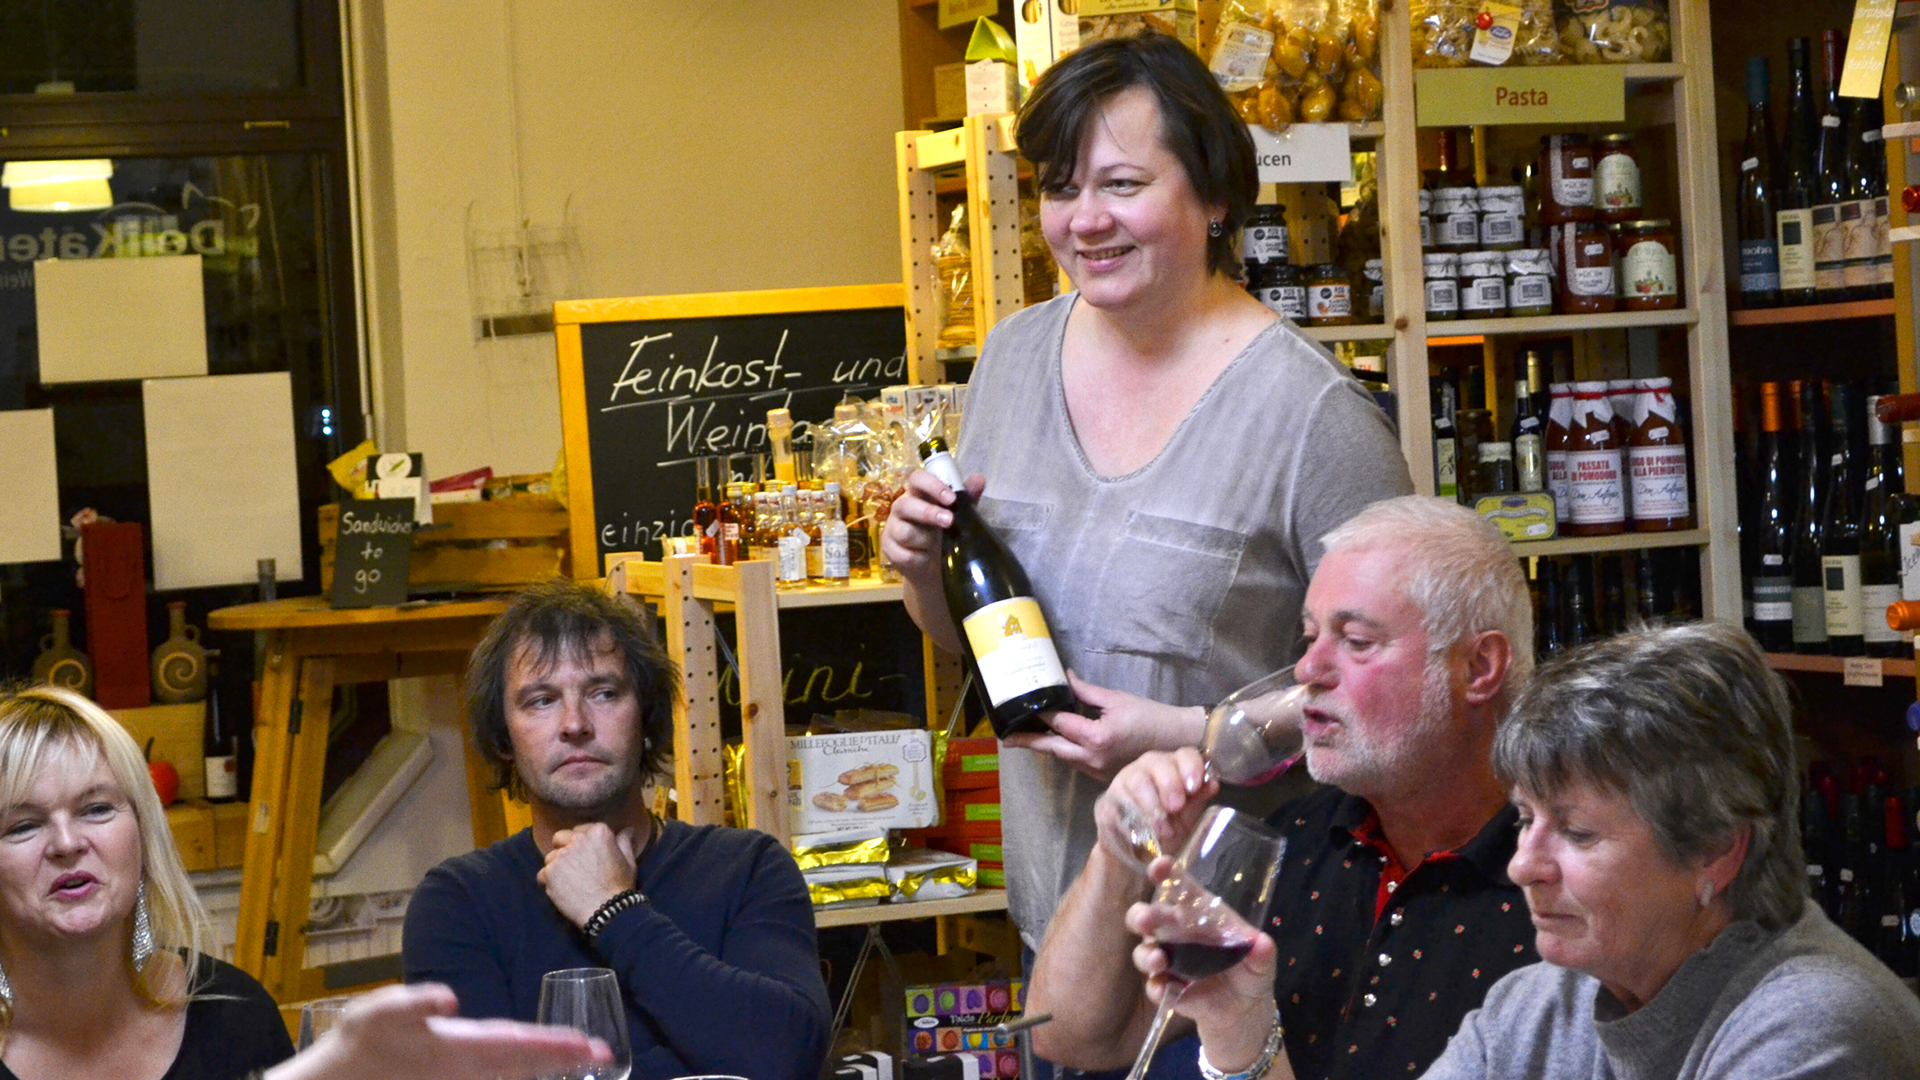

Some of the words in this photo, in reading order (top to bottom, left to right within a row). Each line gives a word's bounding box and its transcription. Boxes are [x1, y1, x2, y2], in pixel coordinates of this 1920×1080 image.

[1496, 87, 1548, 106] Pasta
[1256, 153, 1292, 166] ucen
[610, 329, 802, 402] Feinkost-
[832, 350, 907, 383] und
[360, 541, 384, 560] to
[353, 568, 382, 594] go
[789, 736, 859, 750] MILLEFOGLIE
